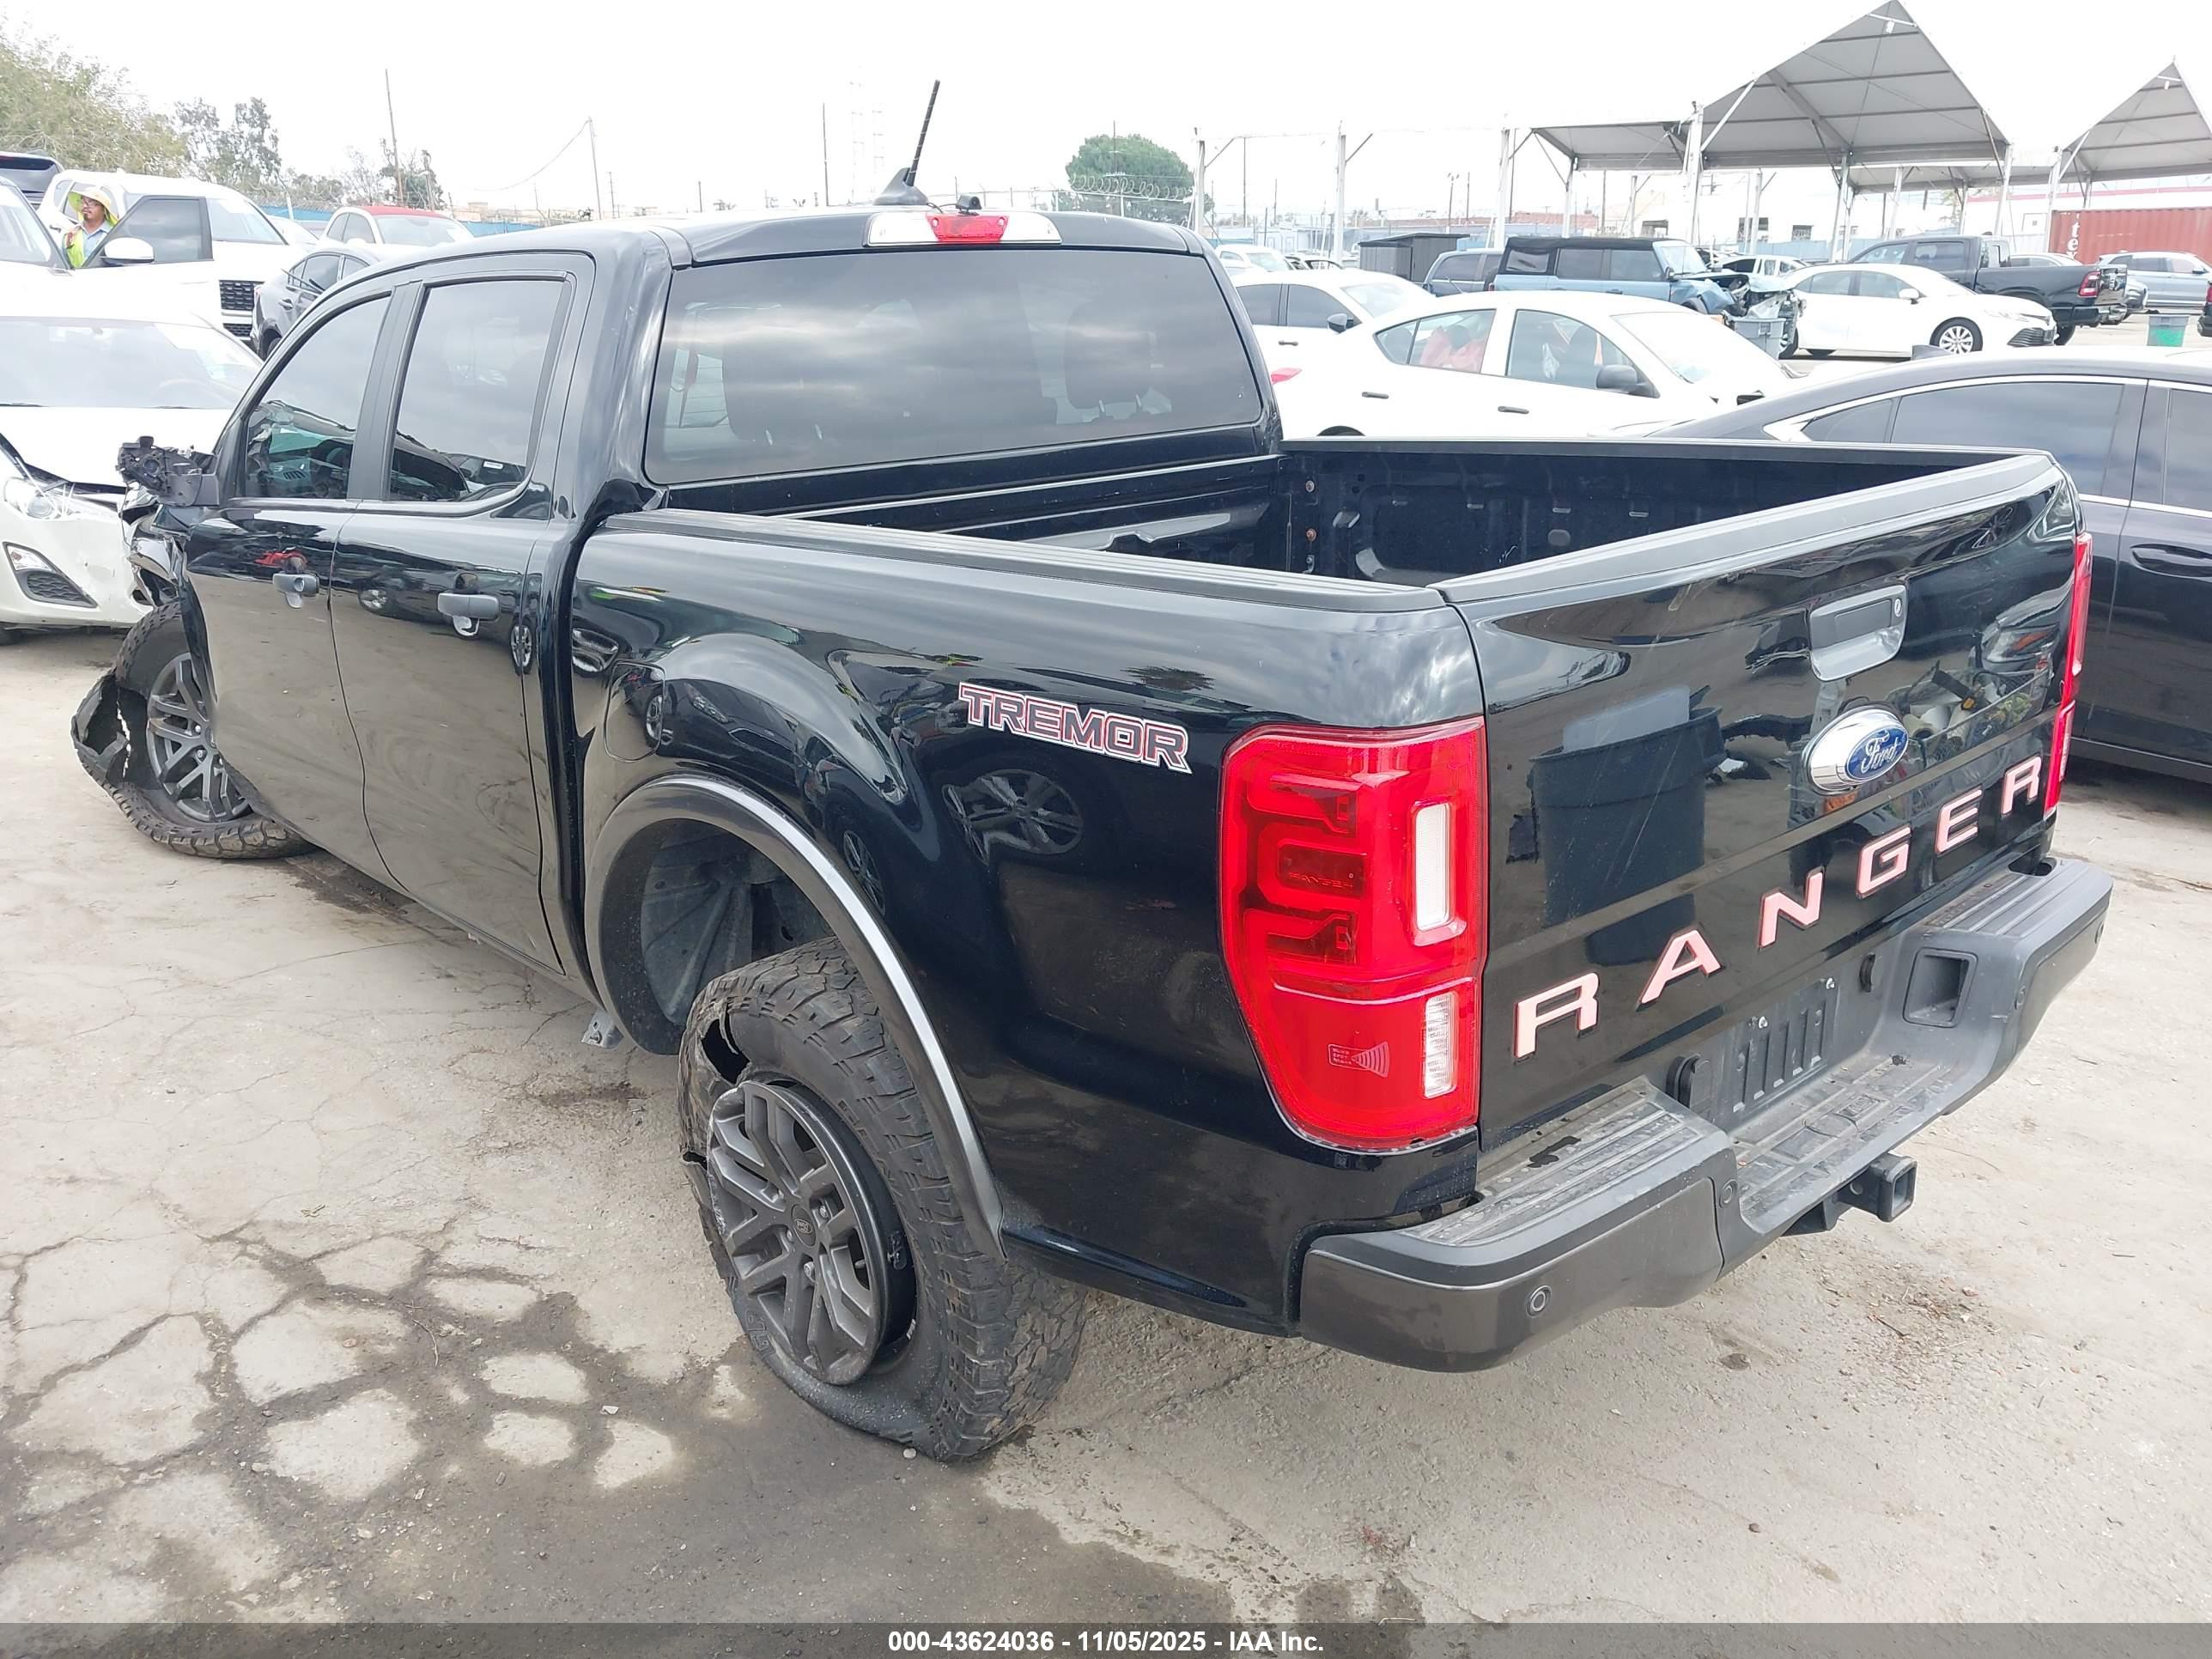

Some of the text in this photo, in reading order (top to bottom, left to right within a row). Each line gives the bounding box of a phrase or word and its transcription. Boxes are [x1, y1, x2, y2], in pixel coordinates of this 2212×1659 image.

[958, 682, 1193, 774] TREMOR
[1860, 729, 1901, 774] Ford
[1513, 756, 2042, 1062] RANGER
